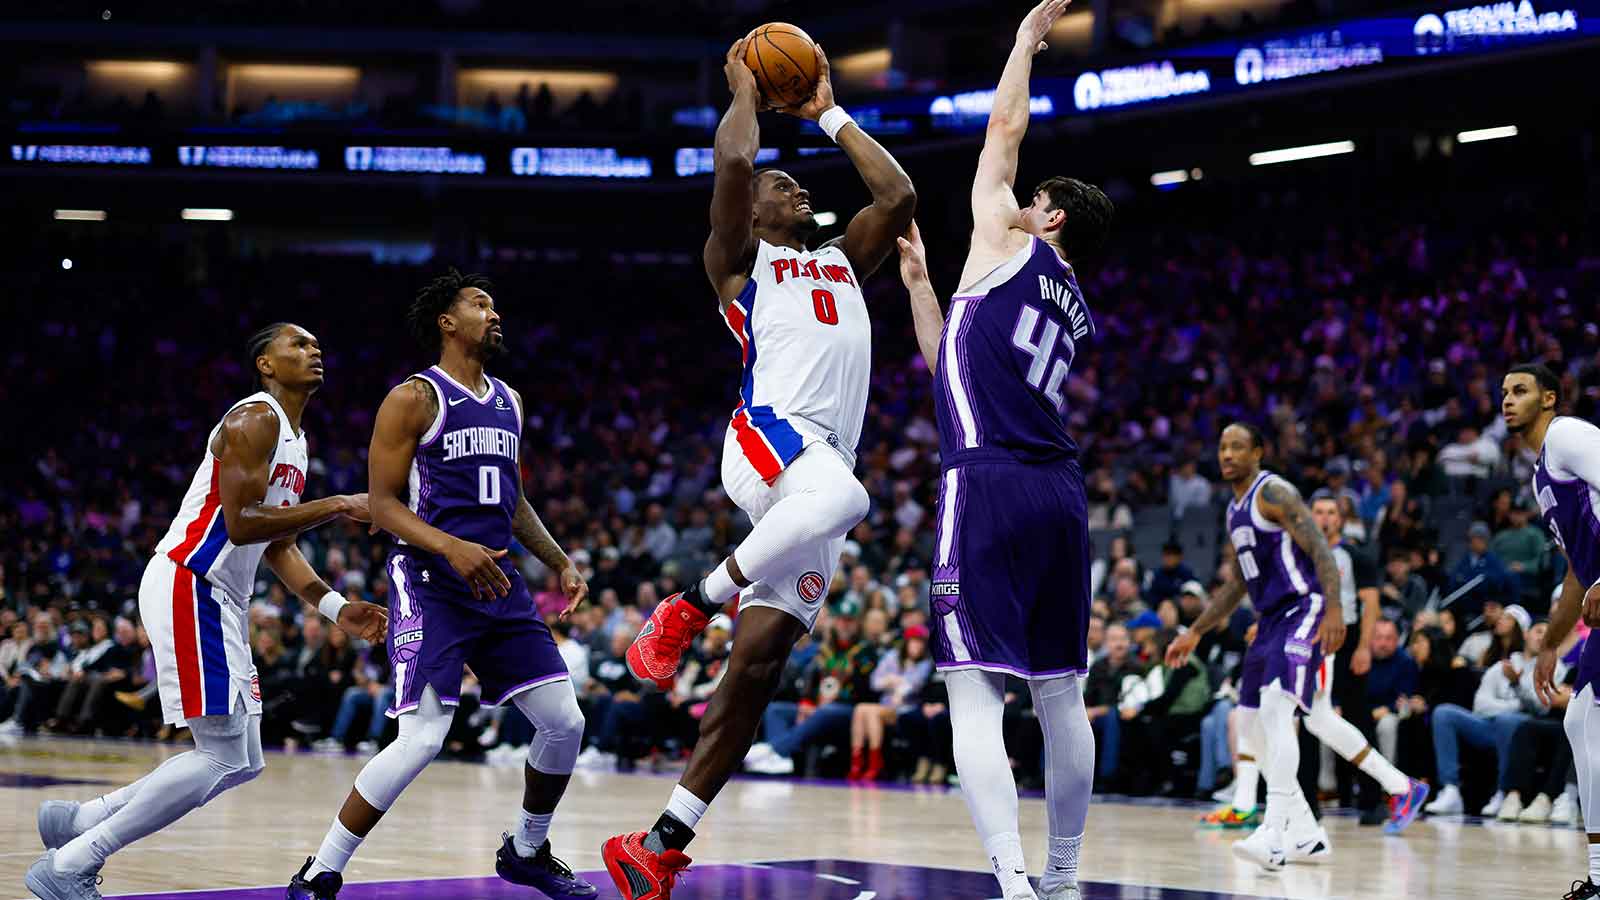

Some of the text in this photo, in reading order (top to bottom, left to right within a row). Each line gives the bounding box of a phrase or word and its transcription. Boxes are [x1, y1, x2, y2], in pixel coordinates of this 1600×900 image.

[811, 288, 839, 326] 0
[1012, 304, 1075, 411] 42
[479, 466, 500, 504] 0
[932, 583, 960, 596] KINGS
[394, 630, 423, 649] KINGS
